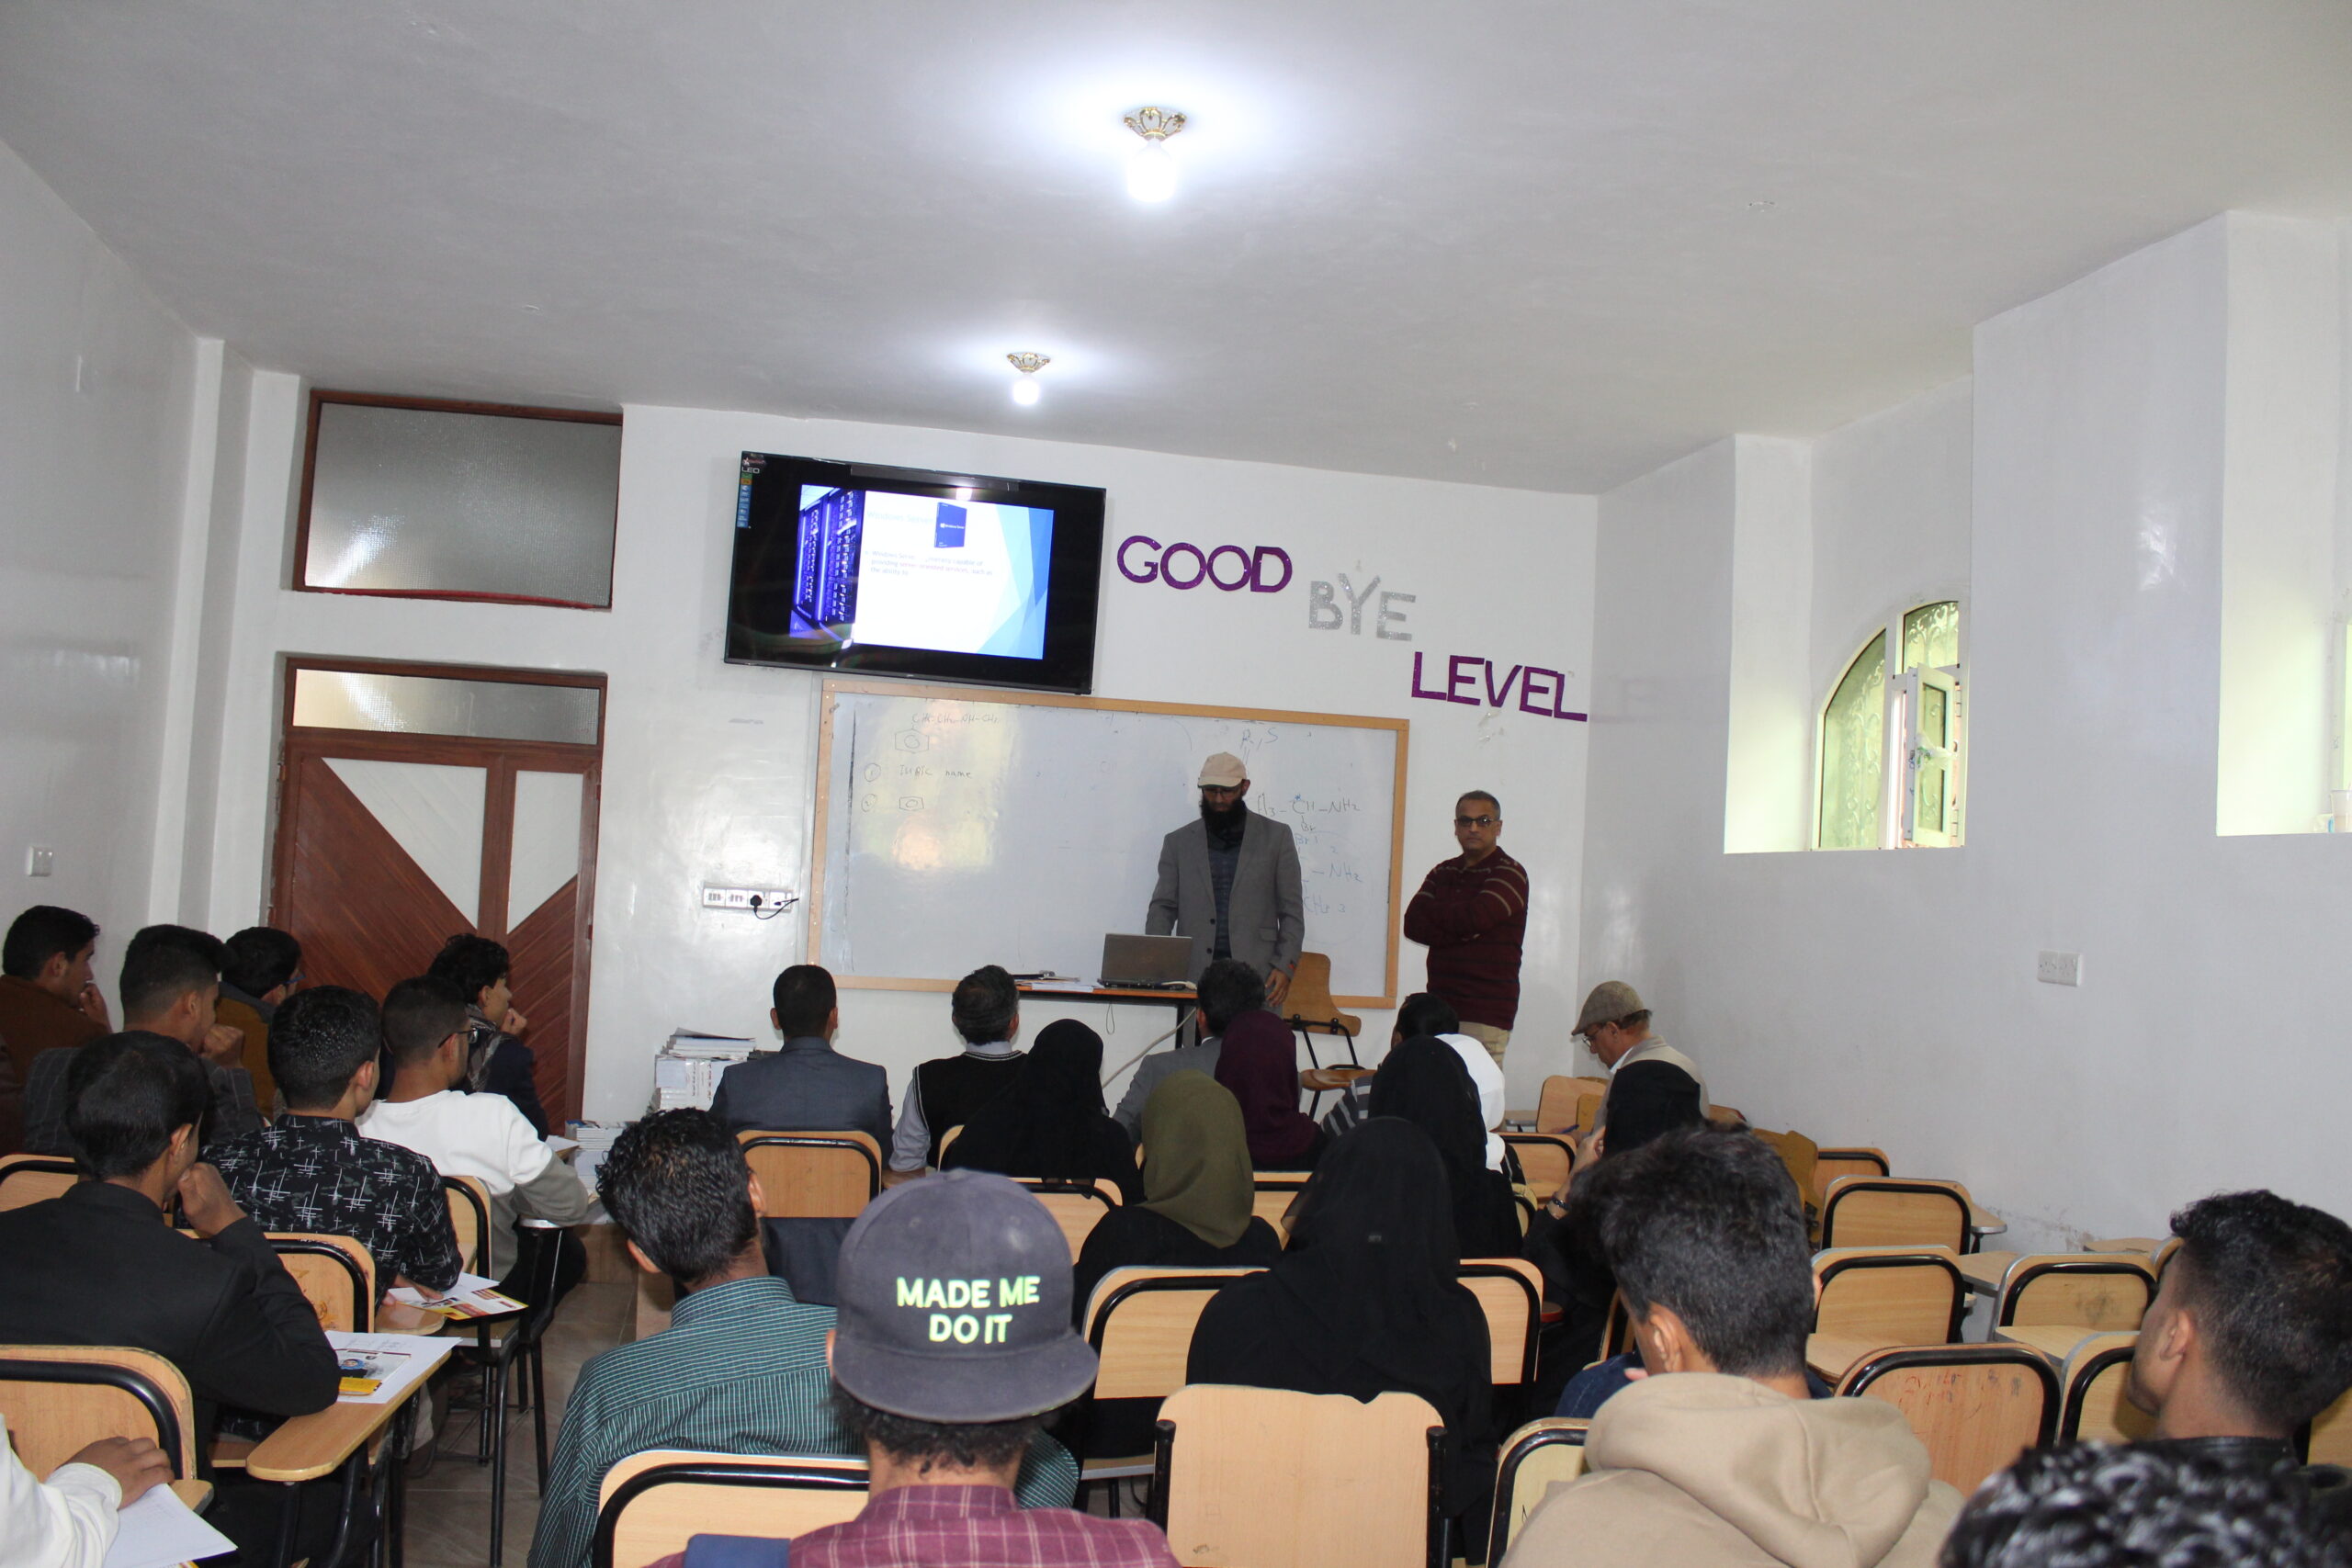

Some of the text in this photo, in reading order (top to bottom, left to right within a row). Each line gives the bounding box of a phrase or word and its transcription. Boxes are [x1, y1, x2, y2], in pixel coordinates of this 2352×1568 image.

[866, 511, 904, 521] Windows
[1116, 535, 1293, 593] GOOD
[1308, 573, 1416, 641] BYE
[1411, 651, 1588, 722] LEVEL
[944, 769, 973, 779] name
[897, 1275, 1041, 1308] MADE ME
[929, 1314, 1012, 1344] DO IT
